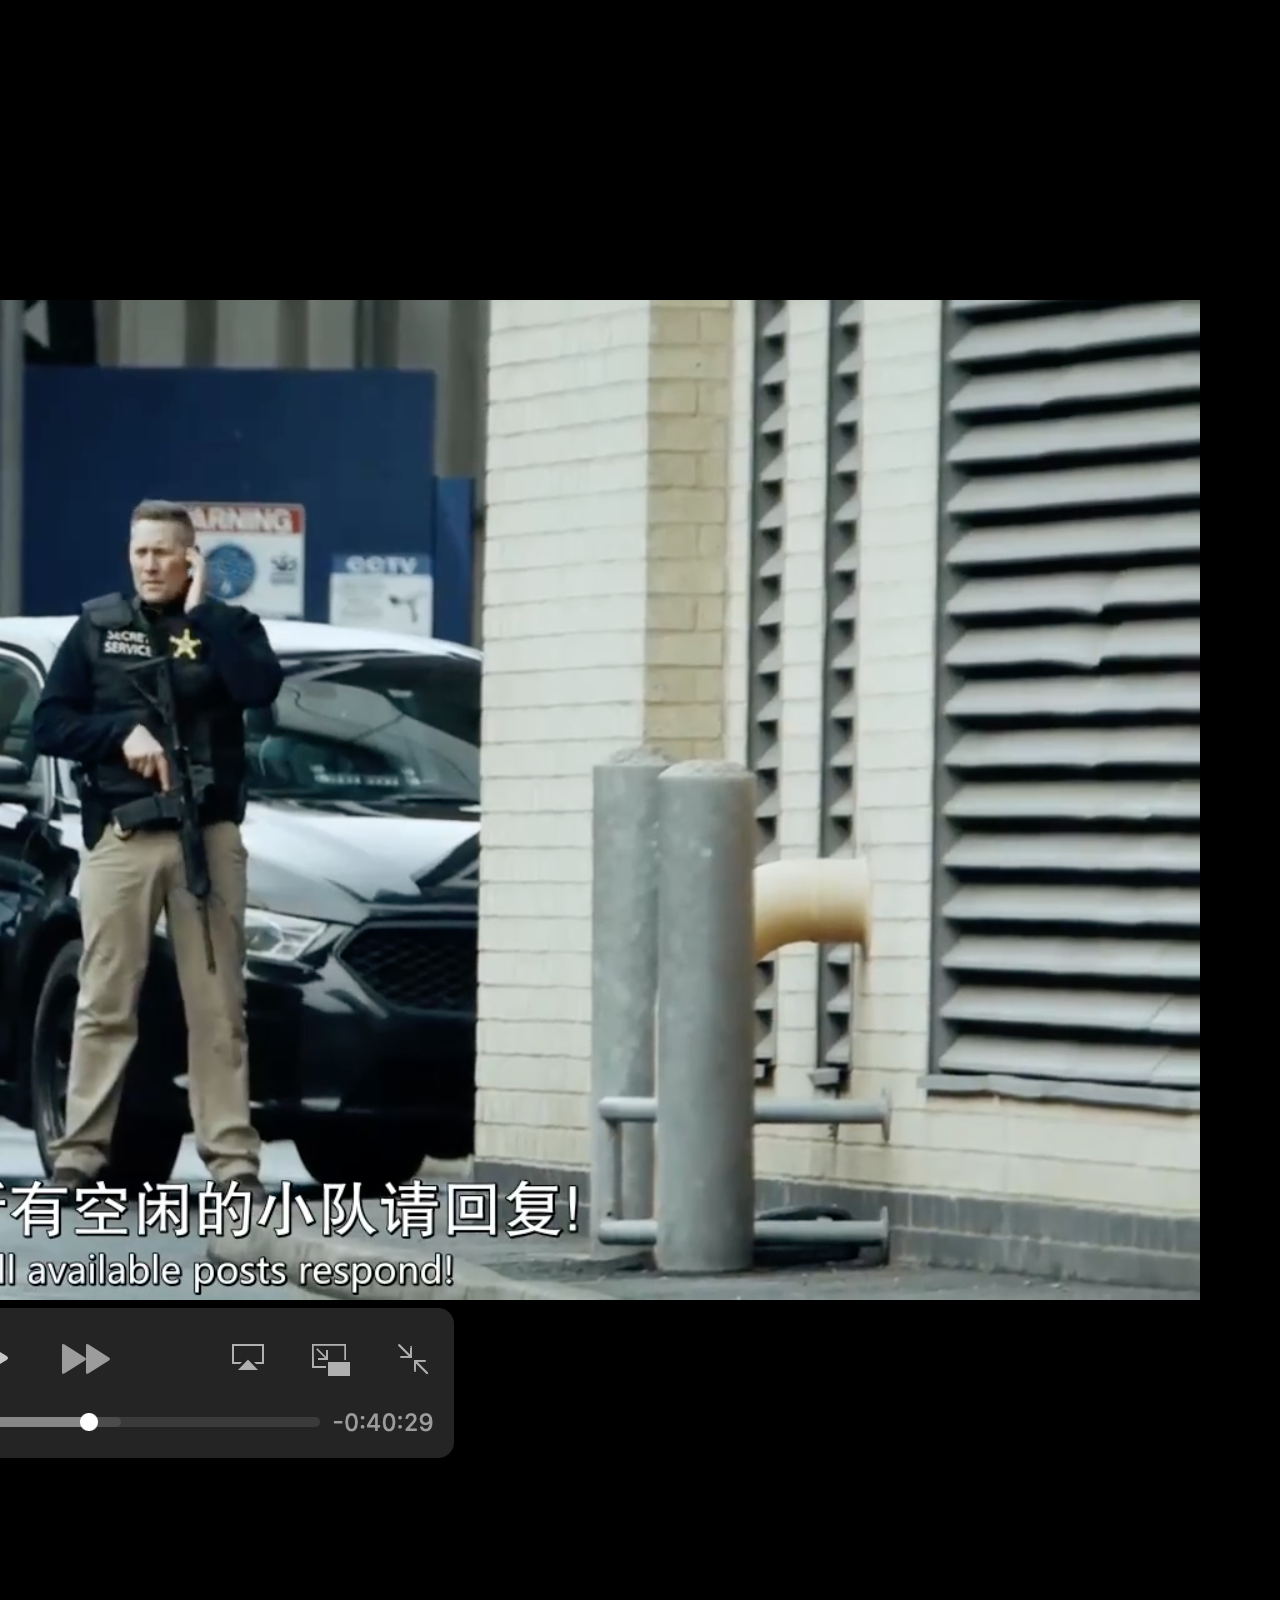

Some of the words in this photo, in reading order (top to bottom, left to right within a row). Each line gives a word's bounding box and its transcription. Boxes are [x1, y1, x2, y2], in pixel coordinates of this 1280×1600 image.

[189, 507, 292, 531] ARNING
[345, 555, 417, 574] CCTV
[104, 640, 152, 657] SERVICE
